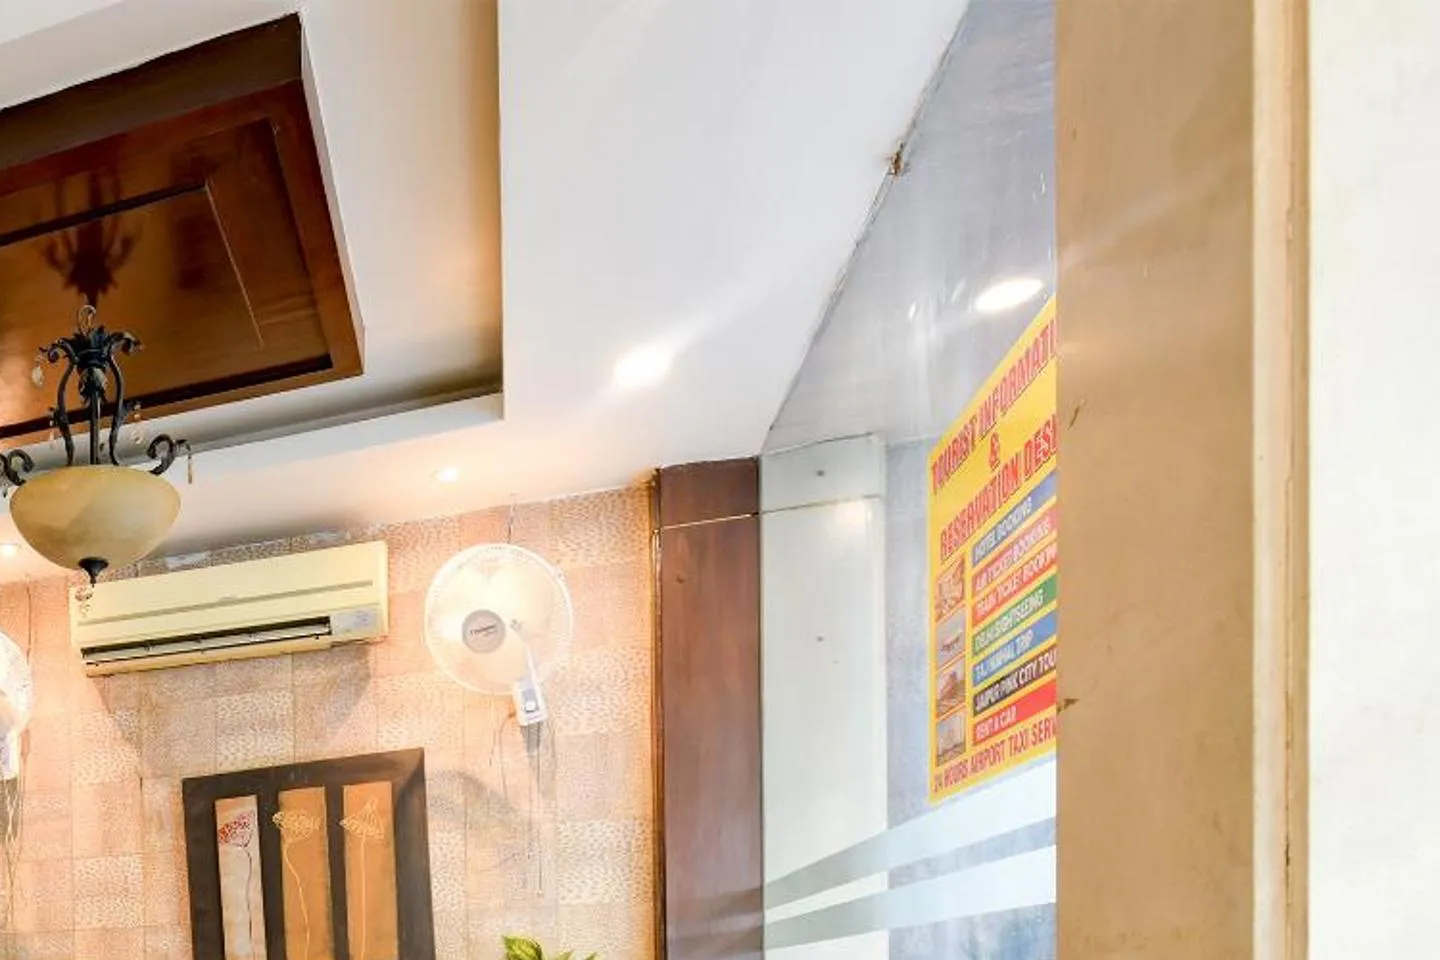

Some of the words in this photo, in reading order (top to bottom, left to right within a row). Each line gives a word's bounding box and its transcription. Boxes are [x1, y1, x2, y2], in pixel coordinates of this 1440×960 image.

[932, 413, 976, 496] TOURIST
[940, 452, 1020, 562] RESERVATION
[1019, 660, 1037, 686] CITY
[1008, 728, 1030, 757] TAXI
